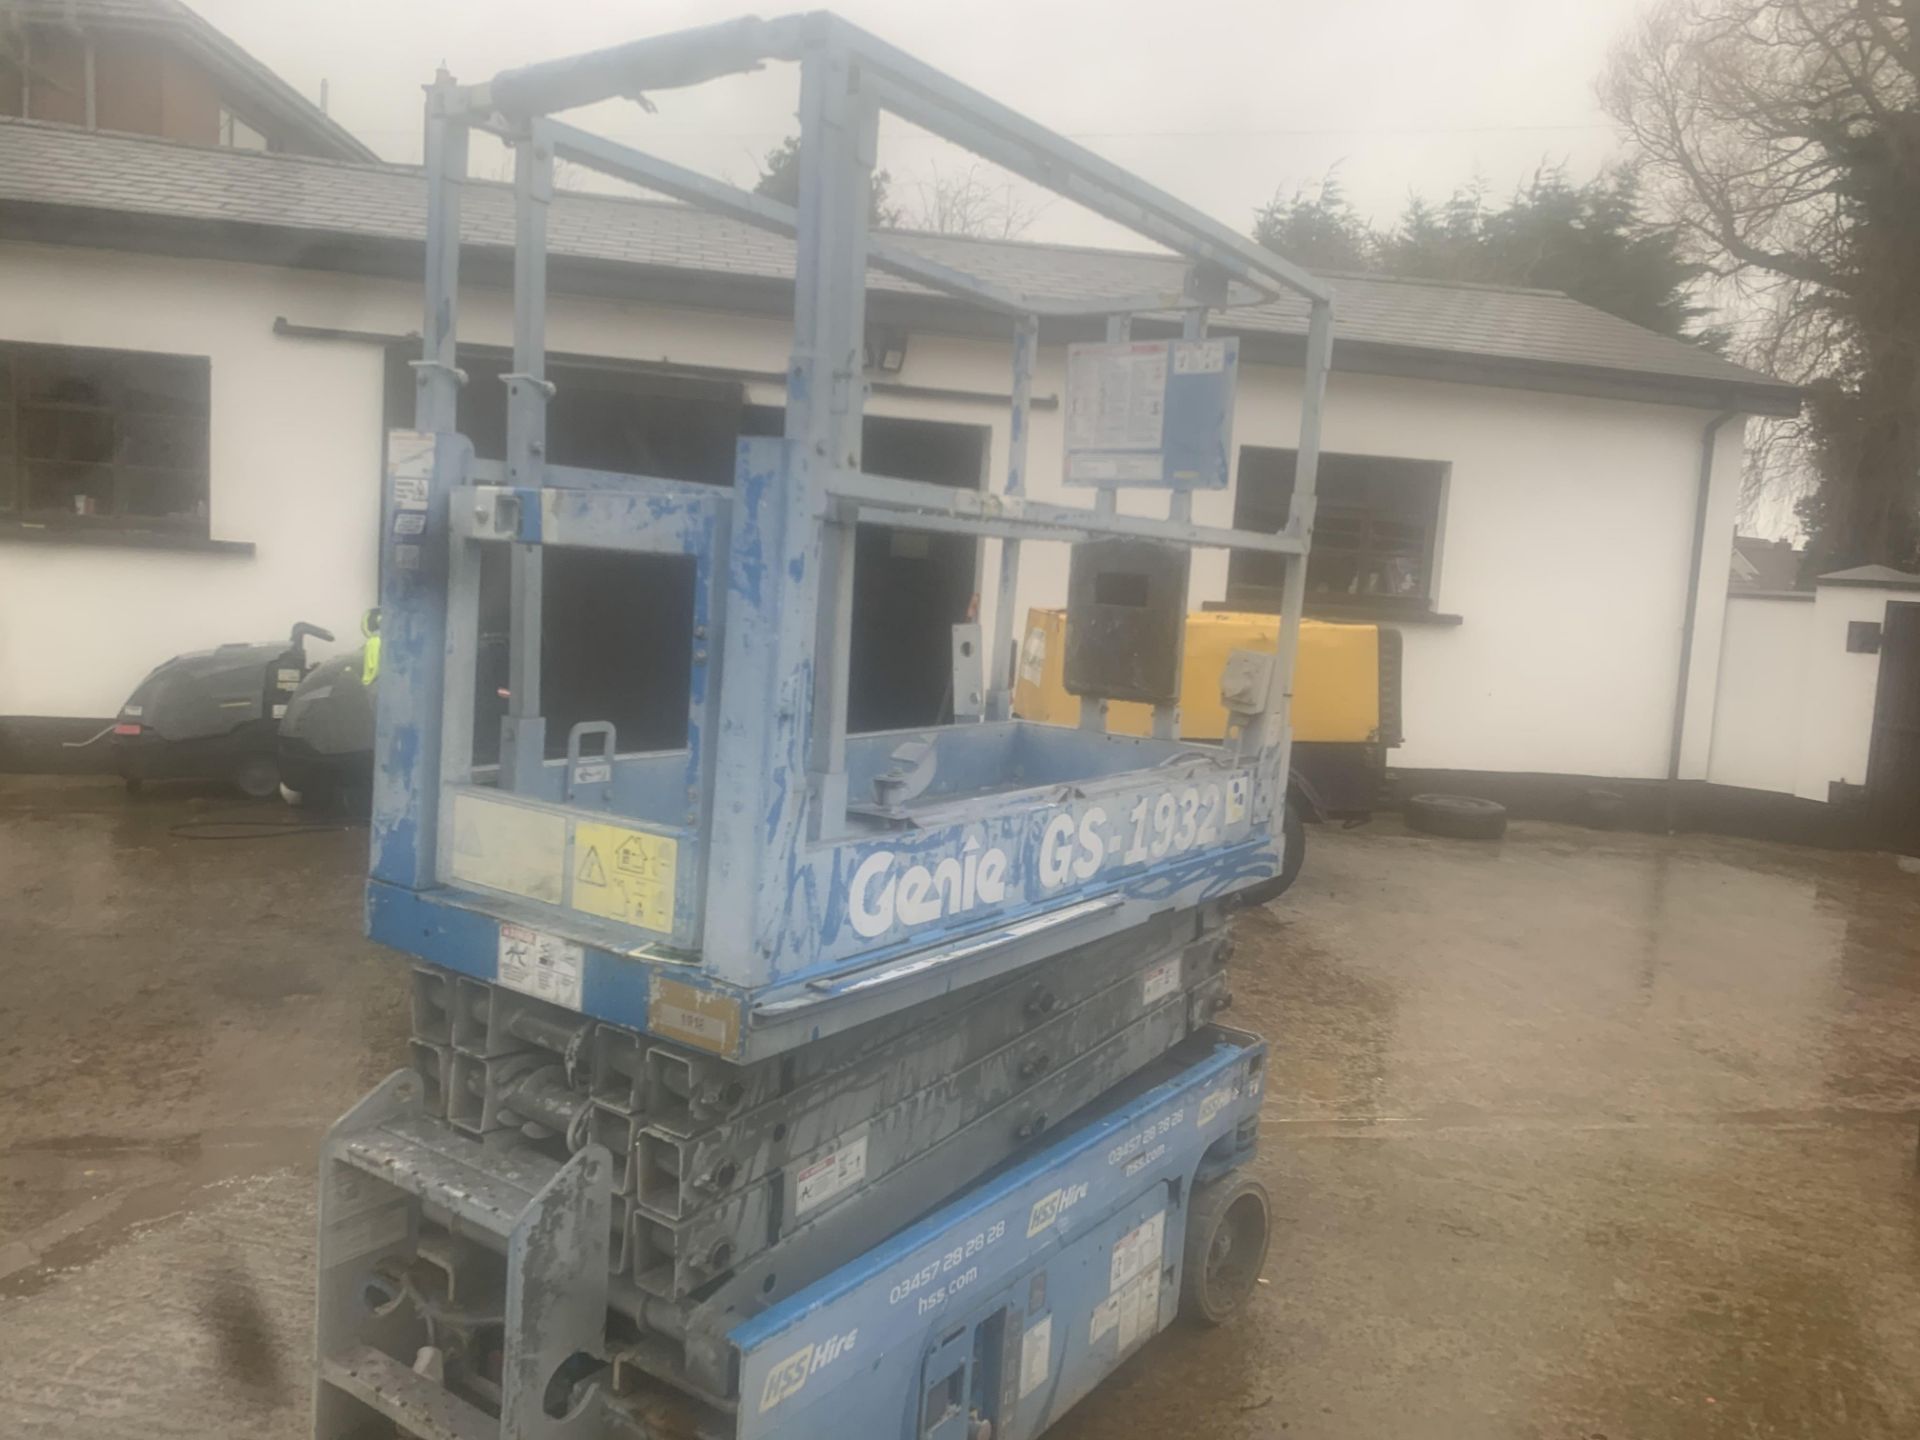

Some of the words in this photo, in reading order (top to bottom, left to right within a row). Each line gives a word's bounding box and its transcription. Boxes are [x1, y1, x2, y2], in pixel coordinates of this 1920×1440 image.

[850, 837, 1007, 937] Genie
[1040, 785, 1219, 888] GS-1932
[889, 1261, 940, 1304] 03457
[943, 1247, 963, 1271] 28
[966, 1234, 984, 1257] 28
[987, 1220, 1005, 1244] 28
[918, 1266, 977, 1315] hss.com
